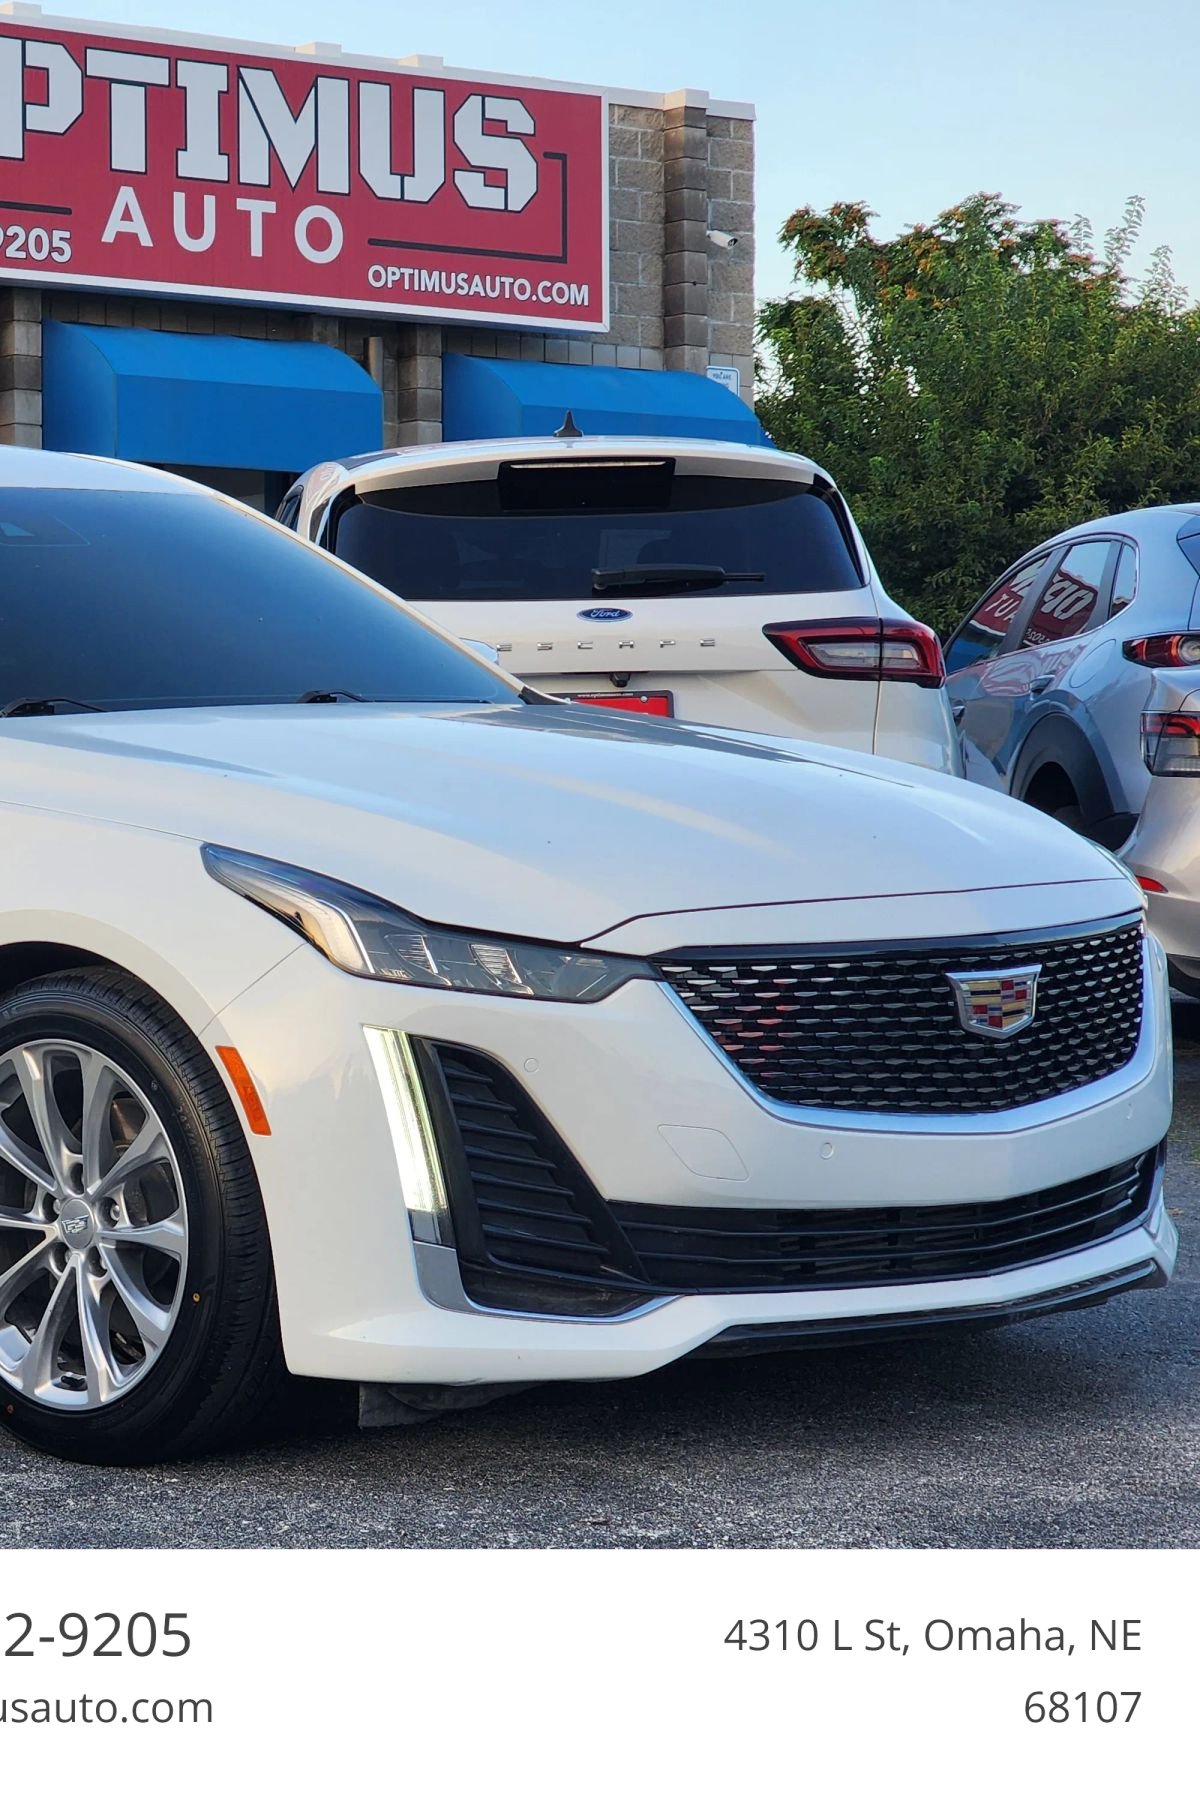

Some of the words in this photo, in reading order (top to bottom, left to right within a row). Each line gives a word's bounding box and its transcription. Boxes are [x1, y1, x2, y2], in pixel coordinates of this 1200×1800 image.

[101, 185, 344, 264] AUTO
[367, 264, 590, 306] OPTIMUSAUTO.COM
[589, 607, 621, 618] Ford
[496, 638, 716, 652] ESCAPE
